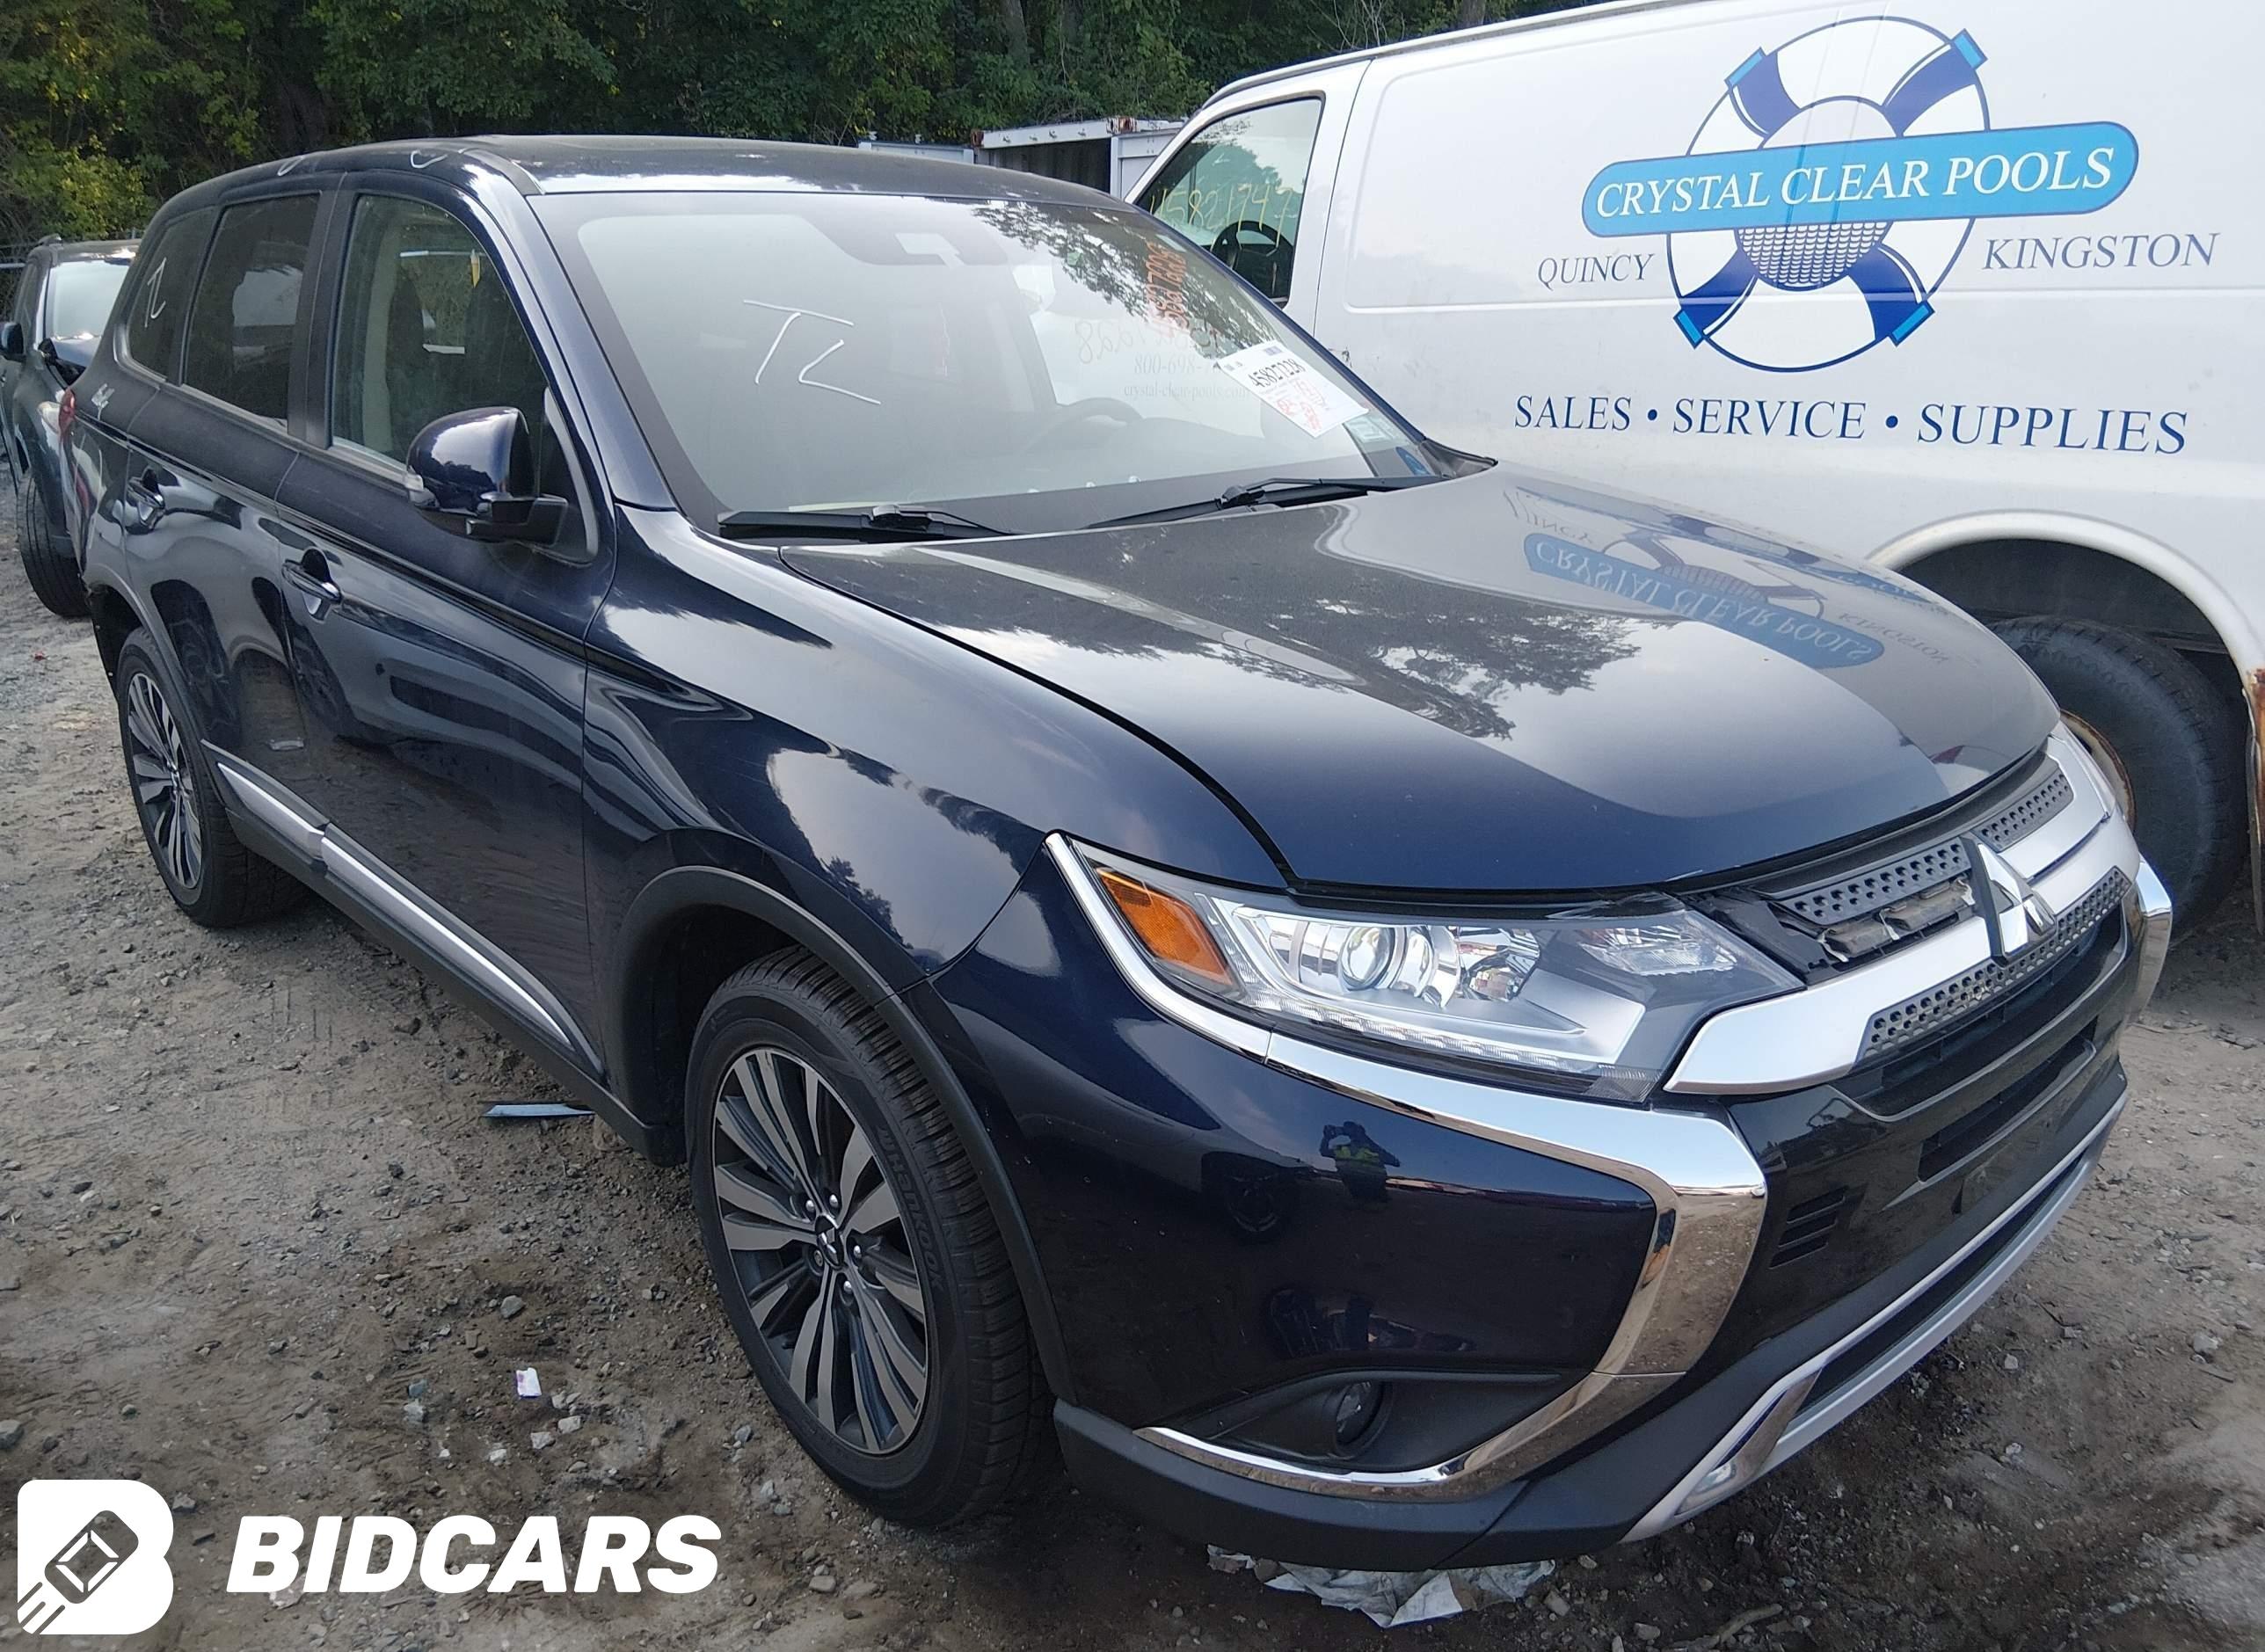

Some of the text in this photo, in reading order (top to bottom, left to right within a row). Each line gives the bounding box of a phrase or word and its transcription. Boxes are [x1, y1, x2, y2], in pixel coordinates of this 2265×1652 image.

[1595, 147, 2115, 219] CRYSTAL CLEAR POOLS
[1537, 252, 1655, 291] QUINCY
[1982, 232, 2221, 270] KINGSTON
[1515, 396, 2189, 455] SALES SERVICE SUPPLIES
